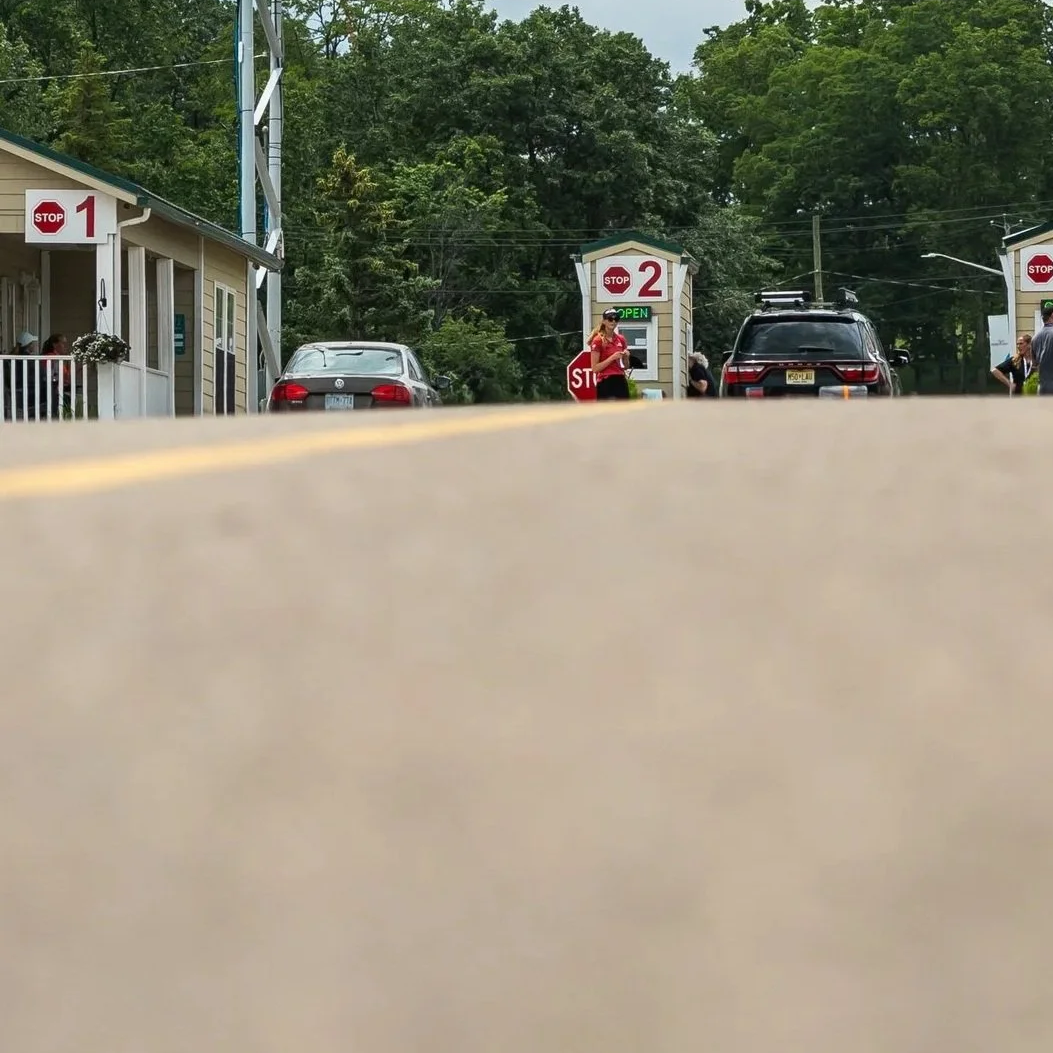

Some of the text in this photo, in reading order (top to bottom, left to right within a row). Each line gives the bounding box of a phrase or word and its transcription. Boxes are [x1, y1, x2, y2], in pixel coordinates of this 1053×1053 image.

[35, 195, 95, 238] STOP 1
[604, 260, 662, 297] STOP 2
[1028, 265, 1053, 274] STOP
[617, 308, 648, 319] OPEN
[571, 368, 597, 389] ST
